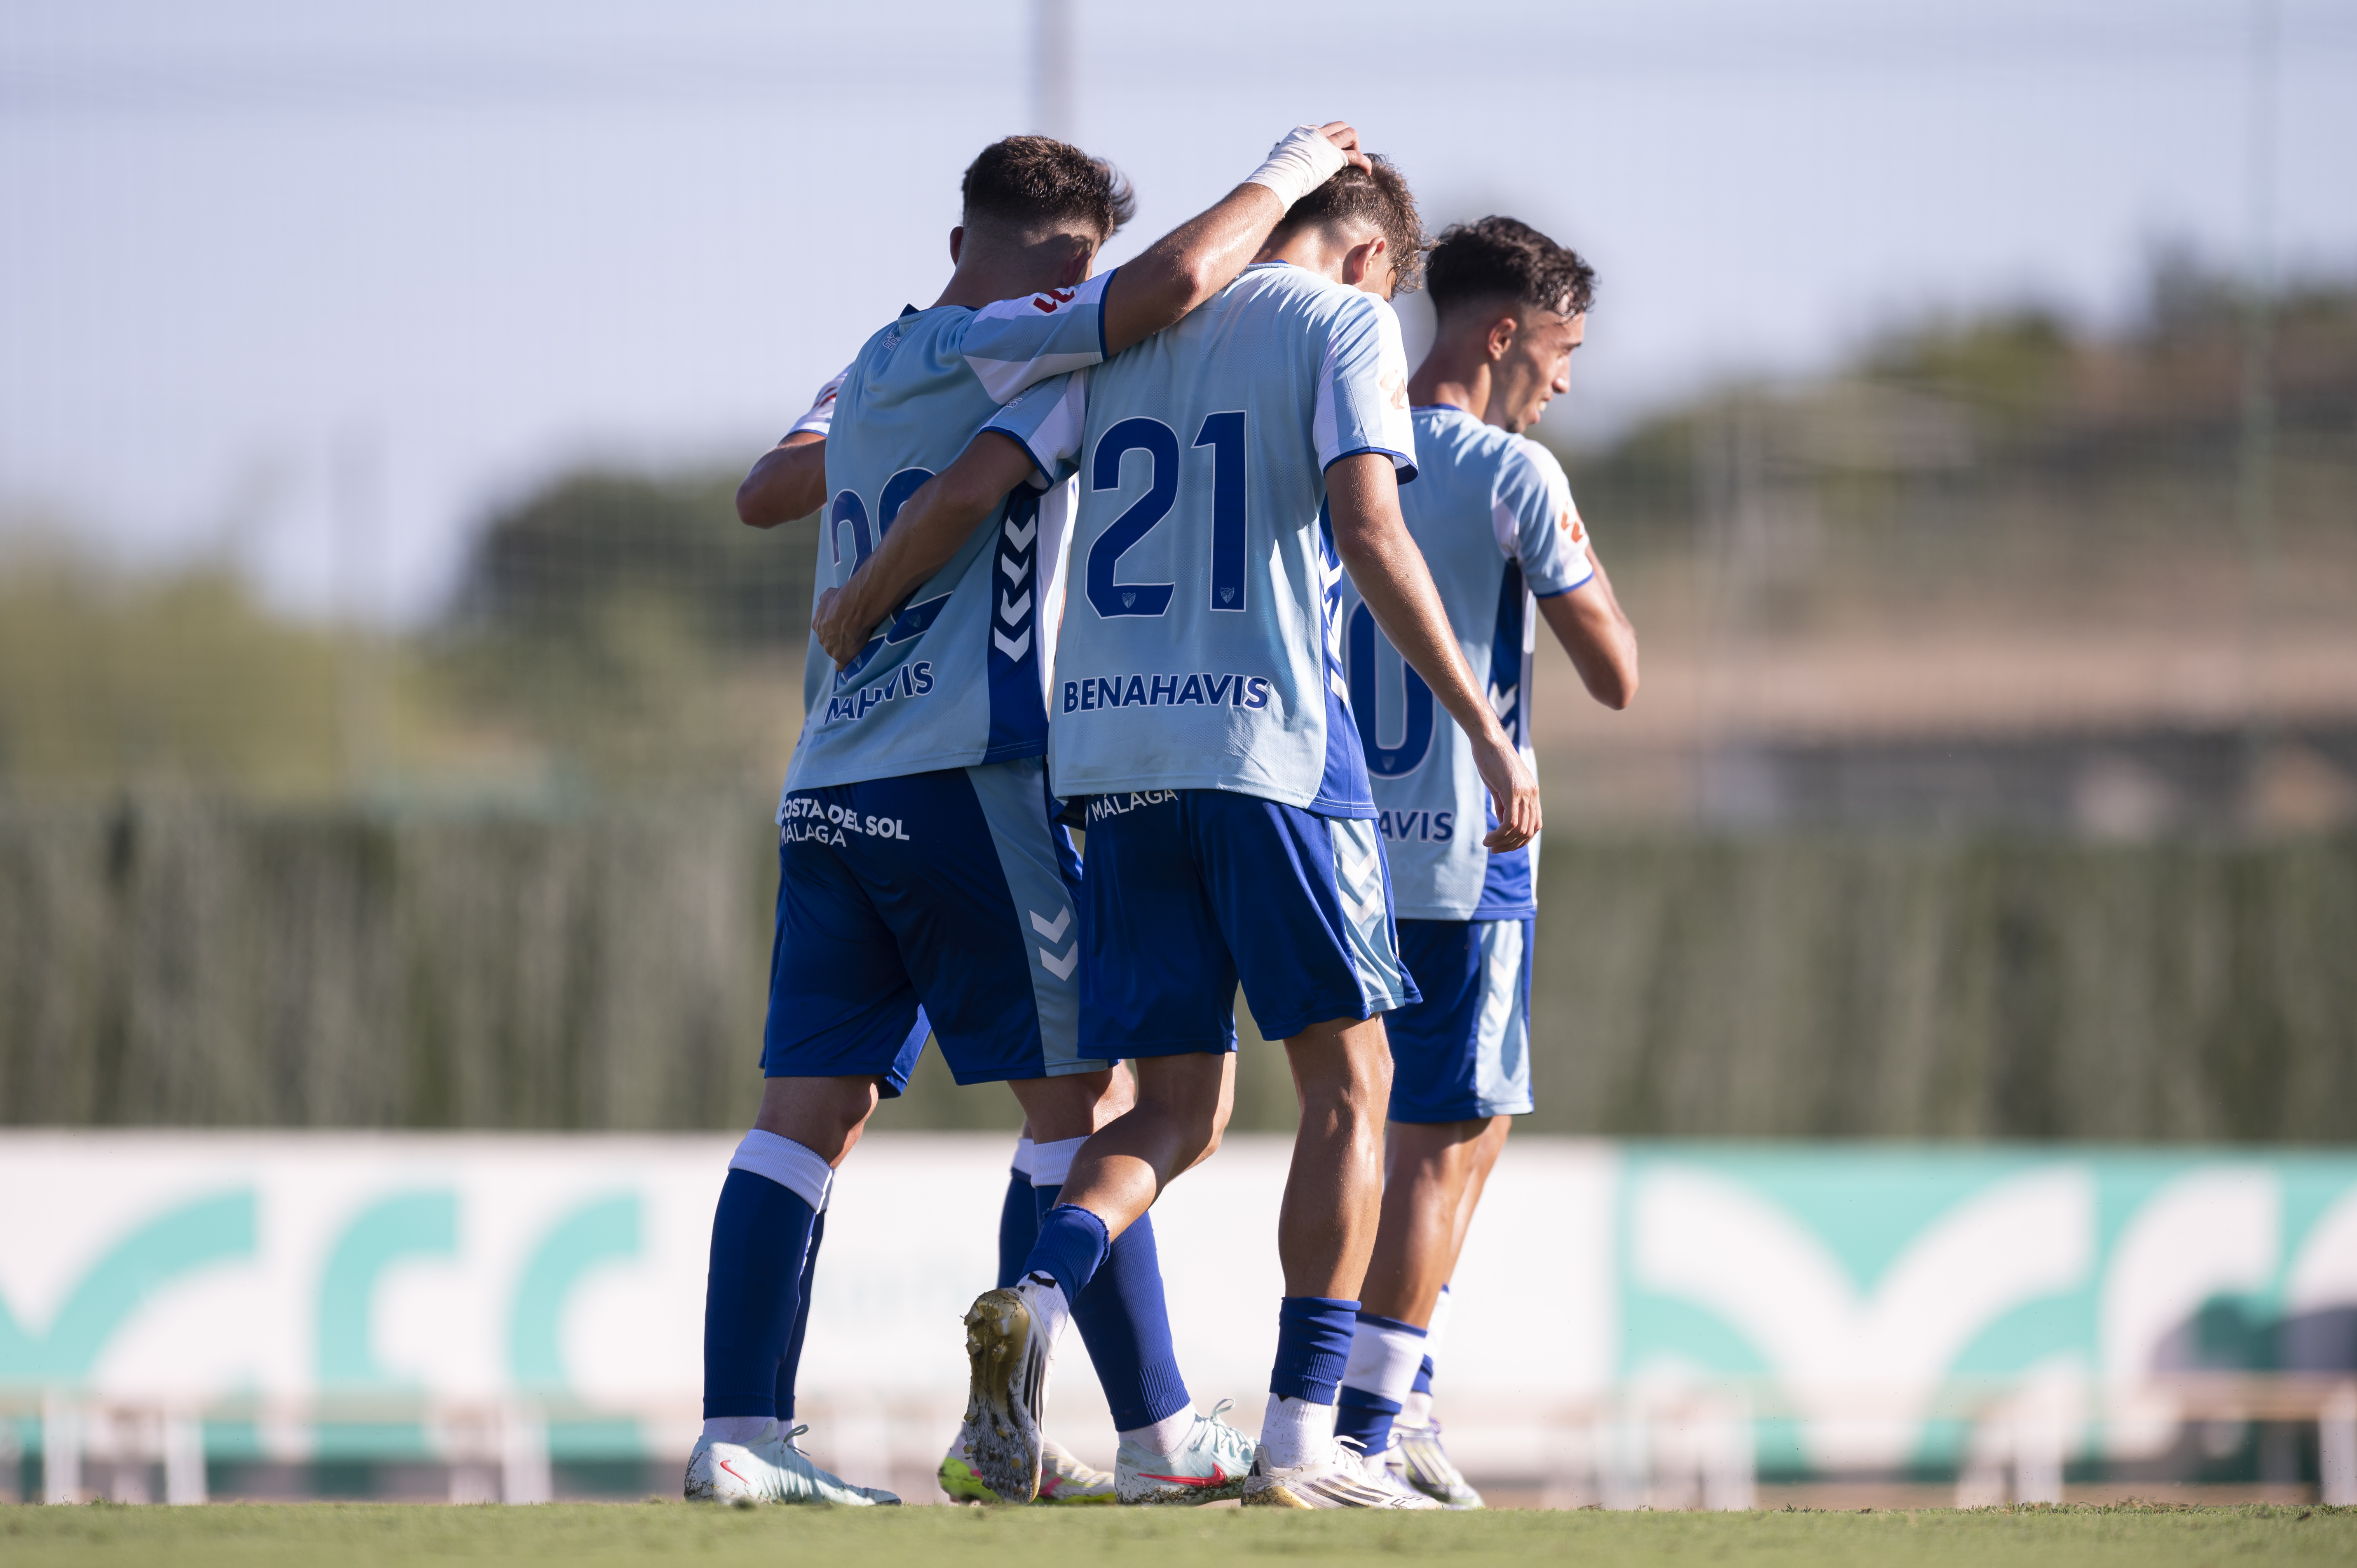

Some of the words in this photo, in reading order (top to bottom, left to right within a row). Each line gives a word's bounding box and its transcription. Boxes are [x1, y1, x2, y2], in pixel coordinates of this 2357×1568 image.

[1085, 409, 1247, 620] 21
[1062, 672, 1273, 715] BENAHAVIS
[828, 804, 863, 833] DEL
[866, 816, 910, 841] SOL
